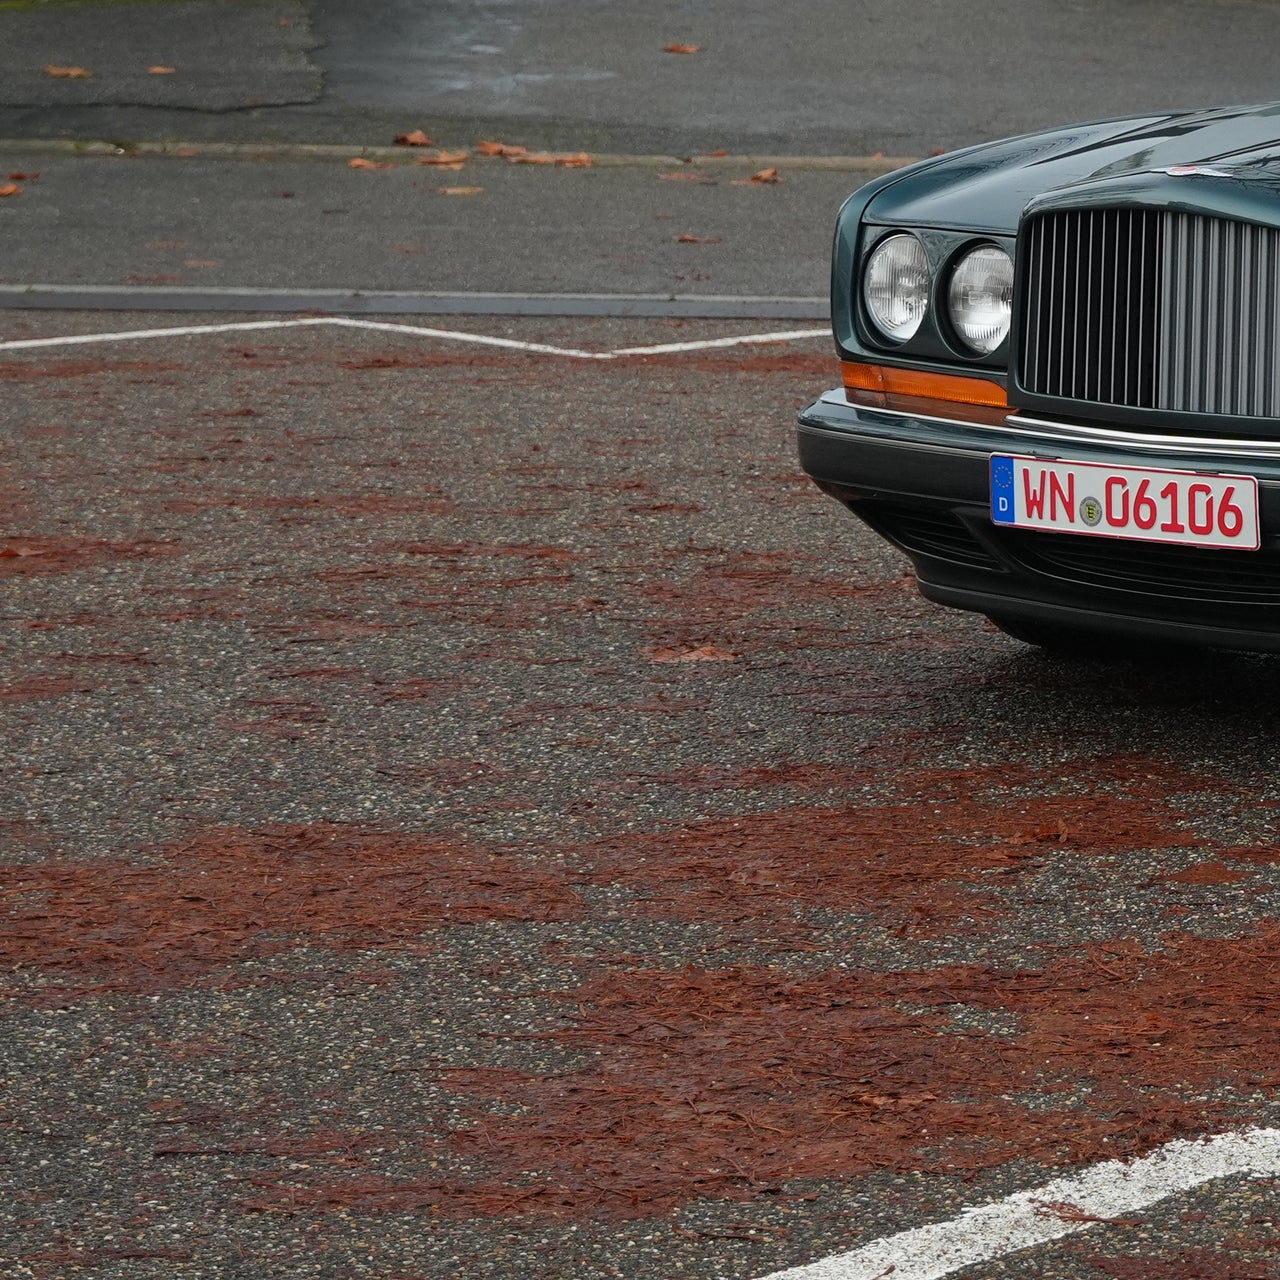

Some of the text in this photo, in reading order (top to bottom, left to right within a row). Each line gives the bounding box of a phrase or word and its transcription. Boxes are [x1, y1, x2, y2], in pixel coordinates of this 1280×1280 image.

[998, 496, 1009, 512] D
[1022, 468, 1244, 538] WN 06106
